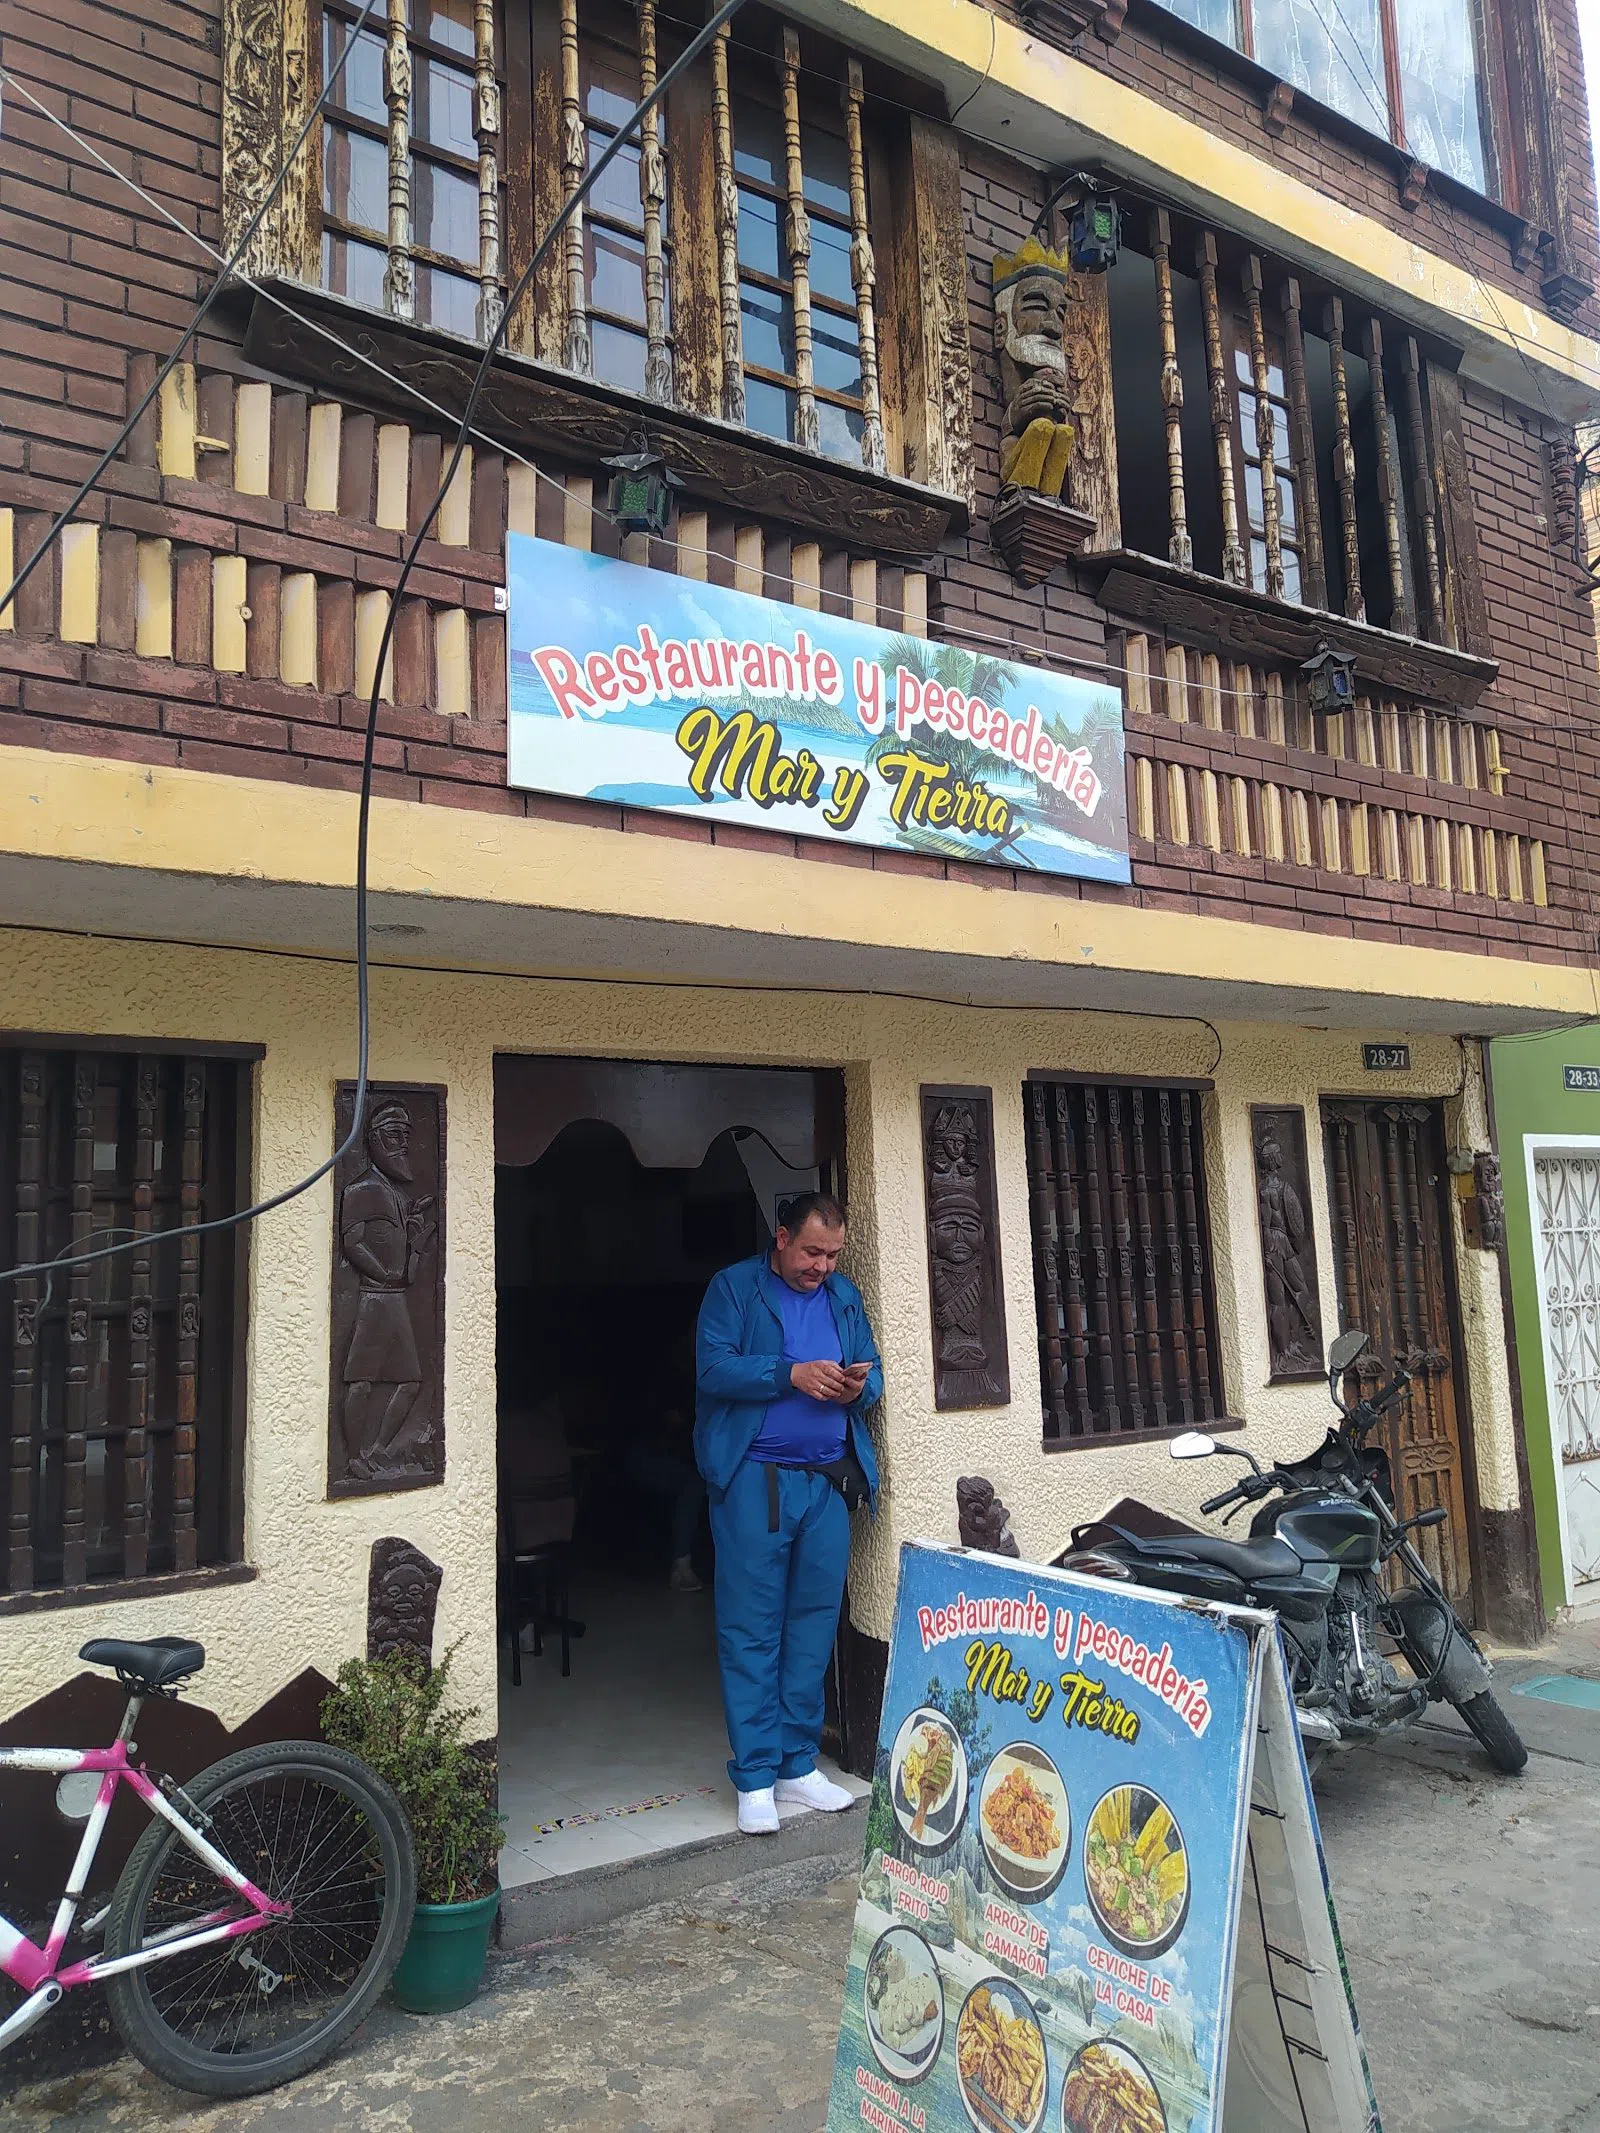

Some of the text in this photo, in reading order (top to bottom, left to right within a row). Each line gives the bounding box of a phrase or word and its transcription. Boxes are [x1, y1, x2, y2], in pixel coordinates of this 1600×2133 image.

[534, 624, 1099, 811] Restaurante y pescadería
[676, 706, 1013, 834] Mar y Tierra
[1370, 1048, 1405, 1067] 28-27
[918, 1590, 1209, 1732] Restaurante y pescadería
[964, 1640, 1141, 1743] Mar y Tierra
[881, 1855, 949, 1903] PARGO ROJO
[897, 1891, 929, 1920] FRITO
[984, 1904, 1048, 1948] ARROZ DE
[984, 1931, 1047, 1978] CAMARÓN
[1087, 1945, 1172, 2003] CEVICHE DE
[1095, 1980, 1155, 2026] LA CASA
[856, 2066, 925, 2130] SALMÓN A LA
